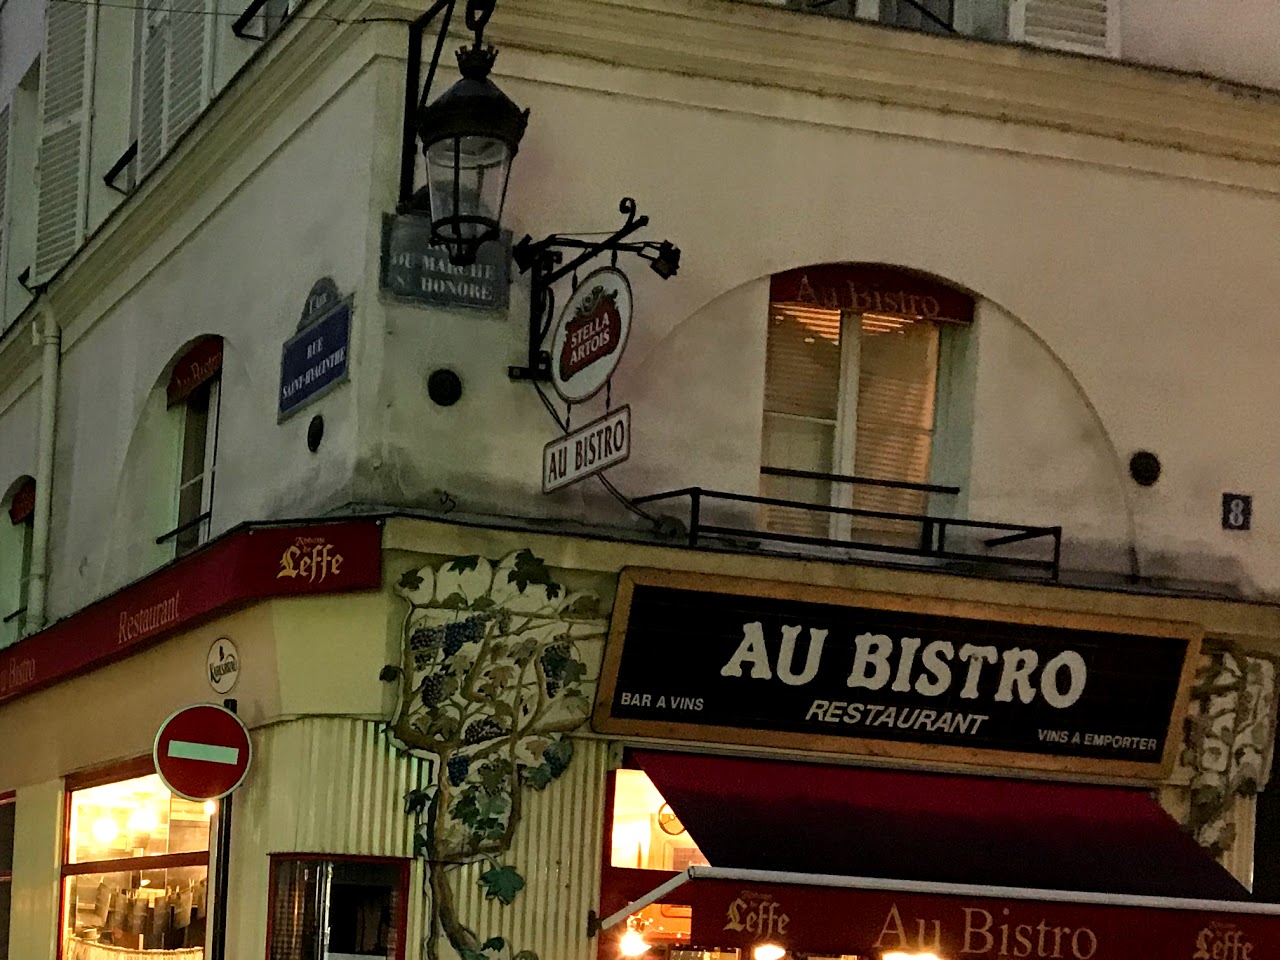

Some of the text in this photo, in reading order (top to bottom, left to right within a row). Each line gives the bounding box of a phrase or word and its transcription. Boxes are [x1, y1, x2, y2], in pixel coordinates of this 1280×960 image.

[306, 336, 324, 360] RUE
[569, 328, 610, 366] ARTOIS
[570, 312, 610, 348] STELLA
[548, 419, 625, 483] AU BISTRO
[1228, 498, 1244, 526] 8
[276, 543, 344, 584] Leffe
[117, 589, 180, 645] Restaurant
[720, 621, 1088, 709] AU BISTRO
[620, 692, 705, 711] BAR A VINS
[805, 699, 990, 735] RESTAURANT
[1037, 728, 1158, 751] VINS A EMPORTER
[722, 897, 791, 939] Leffe
[872, 902, 1098, 960] Au Bistro
